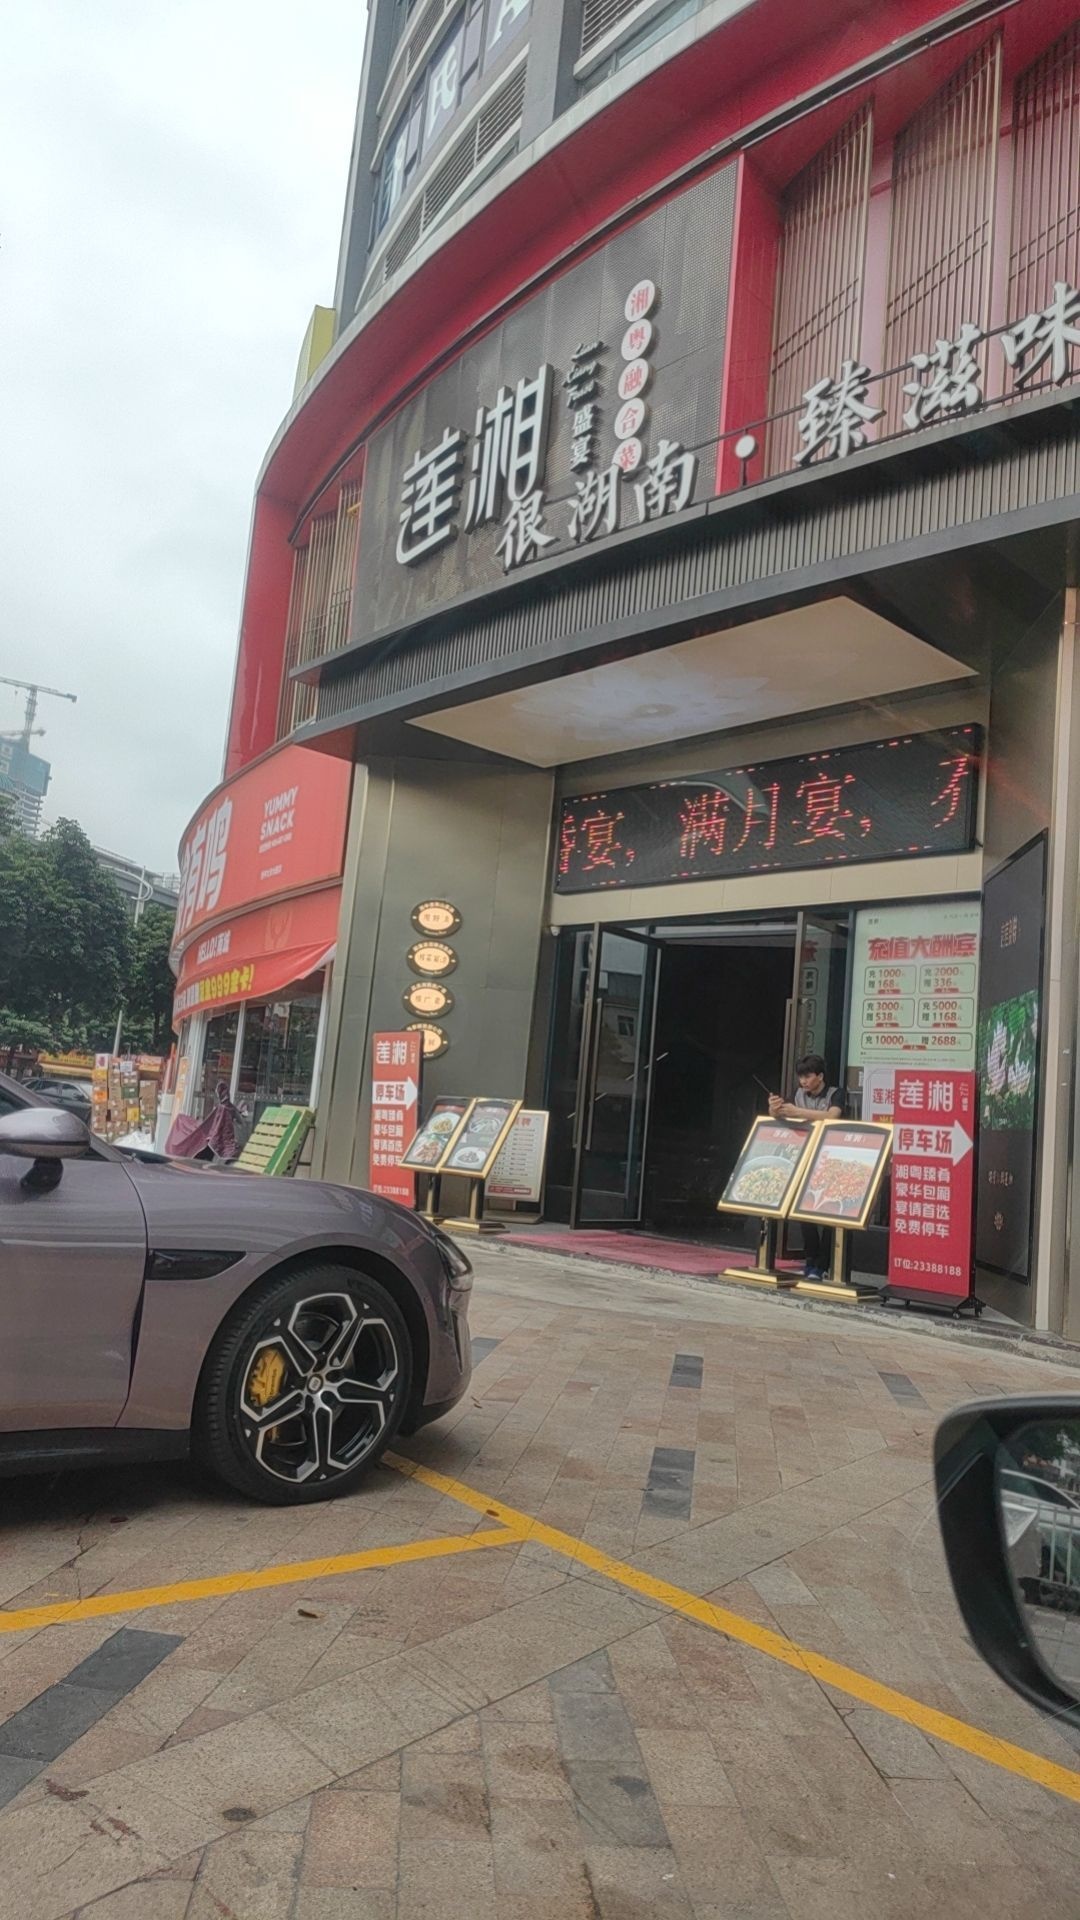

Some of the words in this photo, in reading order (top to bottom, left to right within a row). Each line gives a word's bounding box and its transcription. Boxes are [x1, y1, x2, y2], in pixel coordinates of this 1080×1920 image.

[263, 785, 299, 818] YUMMY
[259, 807, 295, 841] SNACK
[375, 1084, 405, 1101] 停车场
[898, 1079, 954, 1112] 莲湘
[898, 1127, 952, 1154] 停车场
[895, 1182, 951, 1202] 豪华包厢
[895, 1200, 950, 1220] 宴请首选
[894, 1218, 950, 1239] 免费停车
